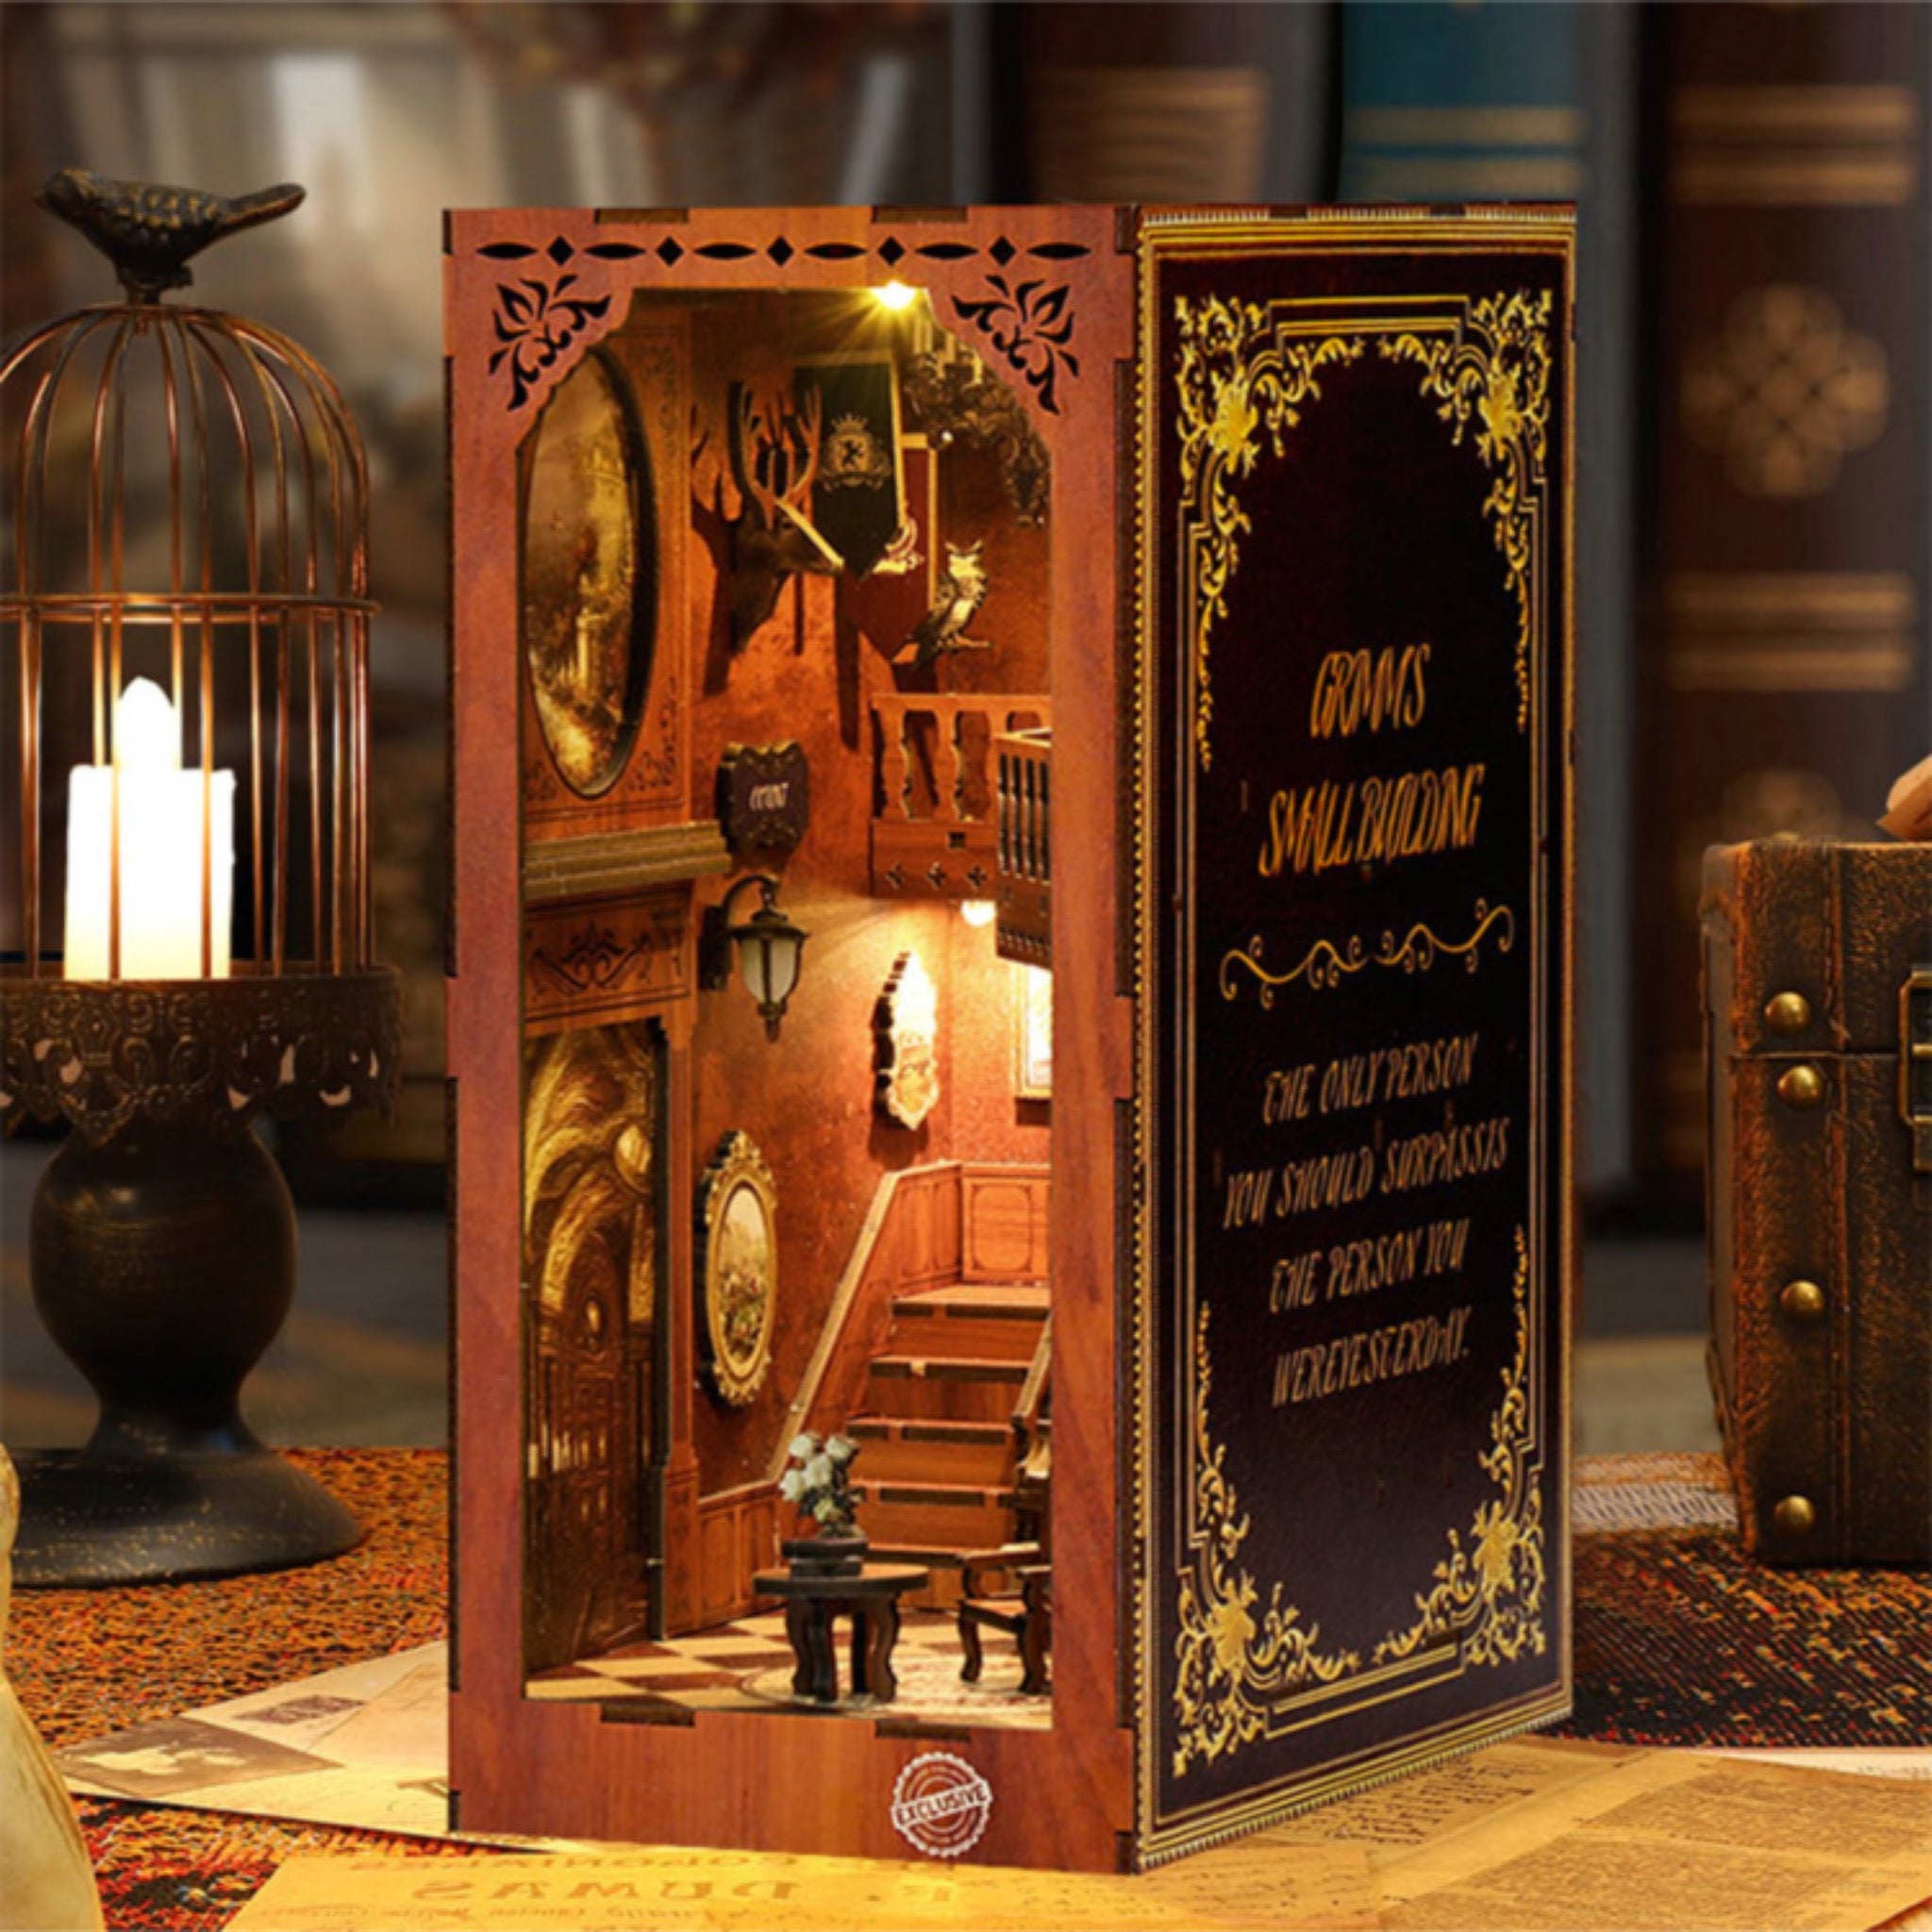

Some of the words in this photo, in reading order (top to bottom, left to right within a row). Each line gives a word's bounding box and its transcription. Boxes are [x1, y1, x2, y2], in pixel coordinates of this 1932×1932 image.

[1384, 1031, 1479, 1101] PERSON
[1325, 1227, 1423, 1300] PERSON
[895, 1783, 988, 1825] EXCLUSIVE
